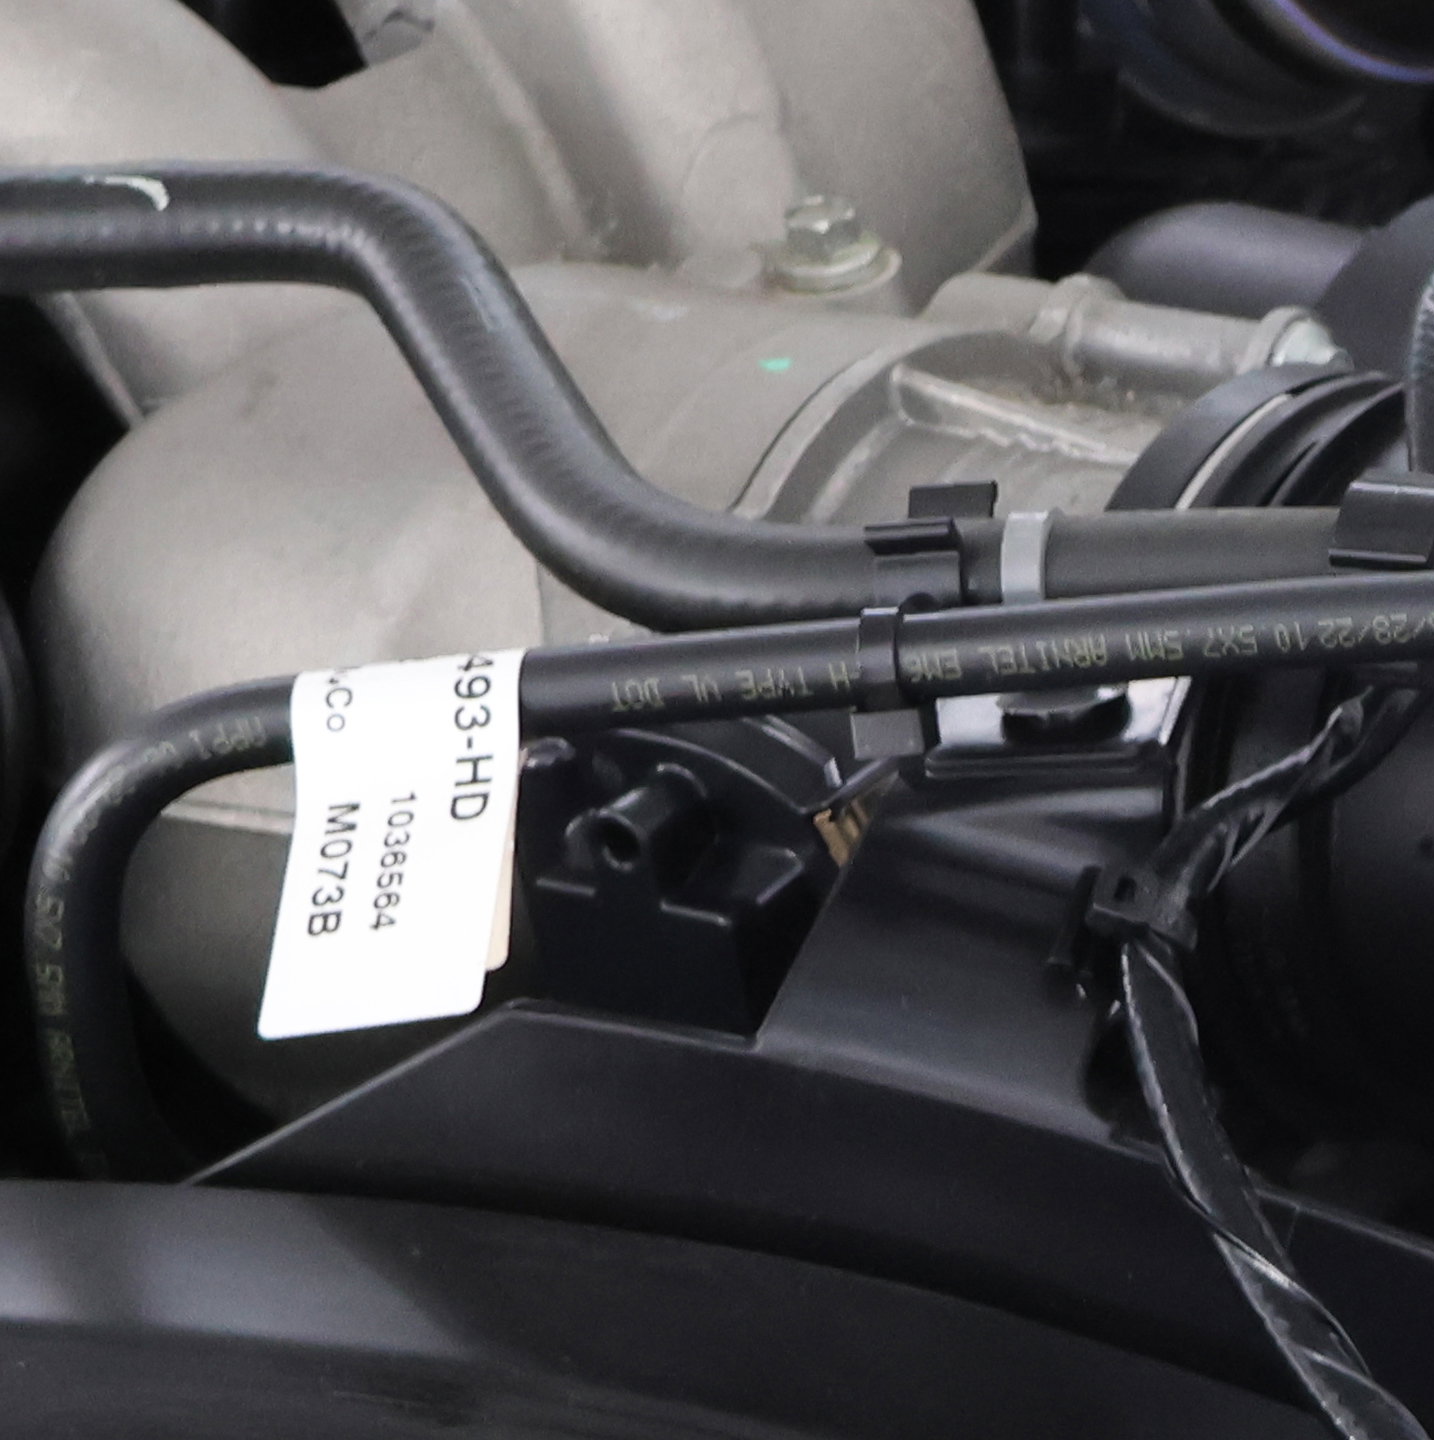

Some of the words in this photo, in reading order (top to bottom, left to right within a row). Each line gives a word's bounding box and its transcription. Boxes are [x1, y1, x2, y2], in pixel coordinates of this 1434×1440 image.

[610, 676, 663, 713] DOT
[735, 663, 815, 705] TYPE
[307, 803, 360, 936] M073B
[370, 791, 417, 932] 1036564
